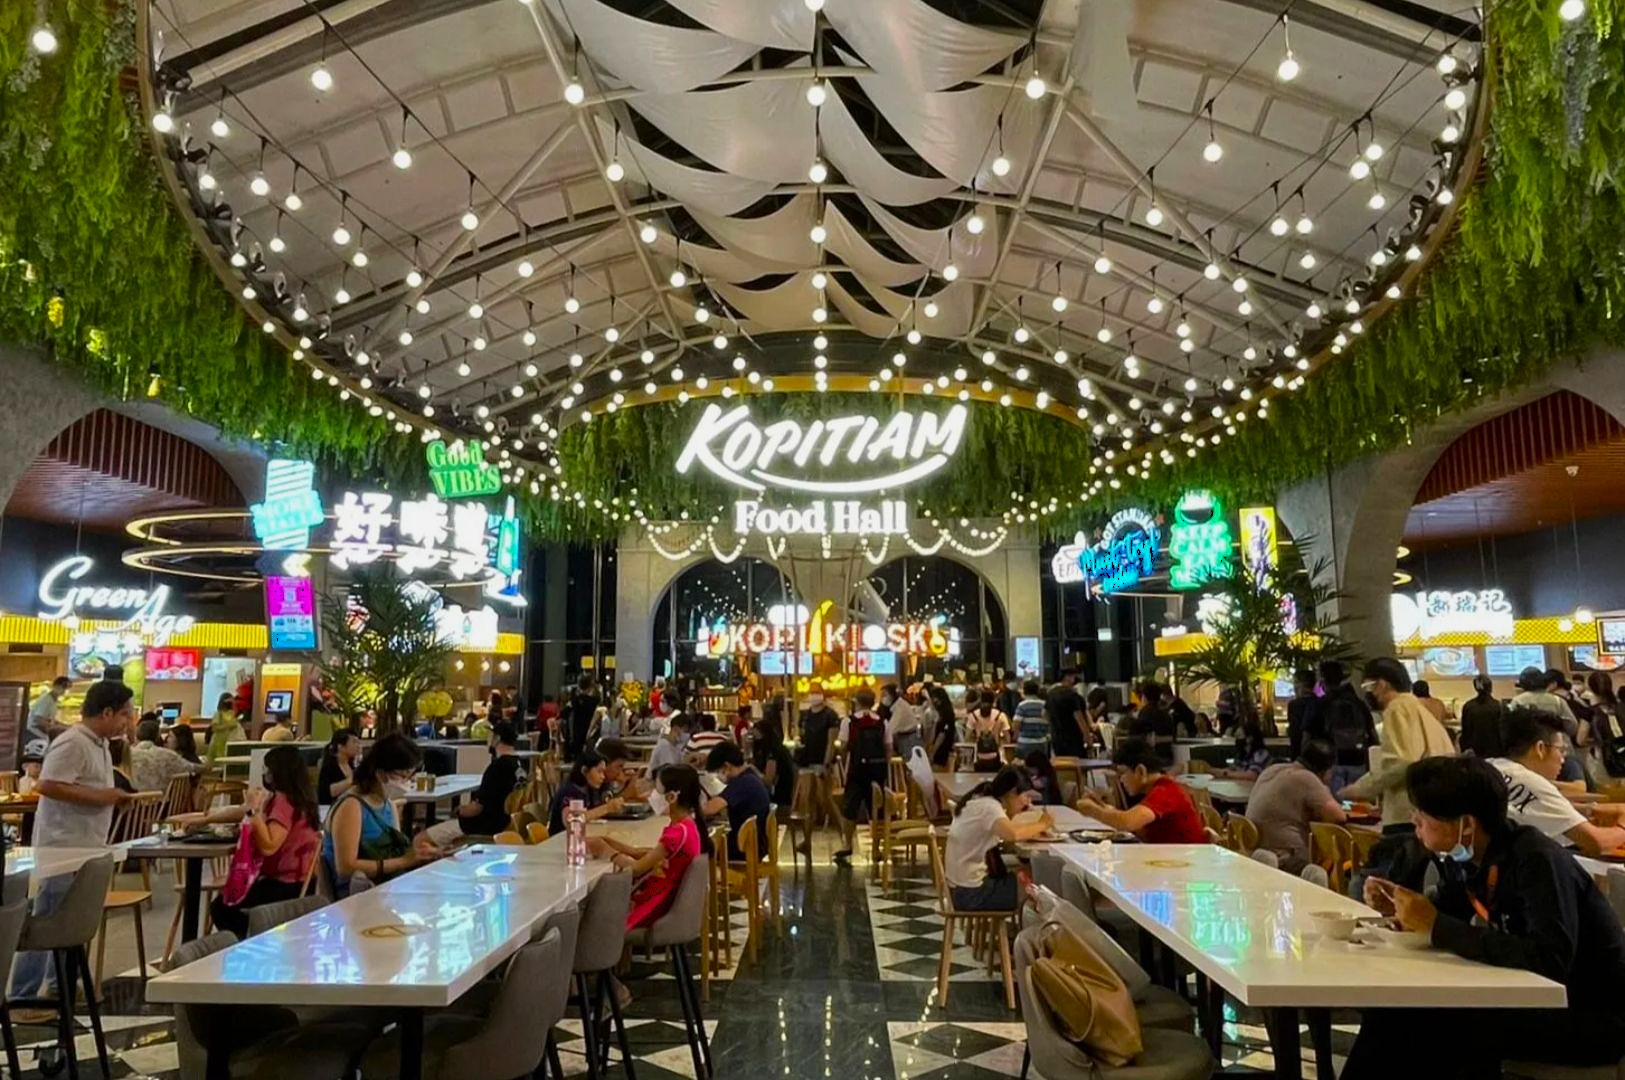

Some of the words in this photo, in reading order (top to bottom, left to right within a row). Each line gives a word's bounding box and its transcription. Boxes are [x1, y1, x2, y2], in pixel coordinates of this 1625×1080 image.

[426, 440, 483, 467] Good
[675, 403, 967, 491] KOPITIAM
[430, 466, 500, 497] VIBES
[735, 500, 827, 534] Food
[832, 500, 908, 534] Hall
[38, 555, 148, 619] Green
[730, 623, 807, 653] KOPI
[826, 623, 927, 653] KIOSK
